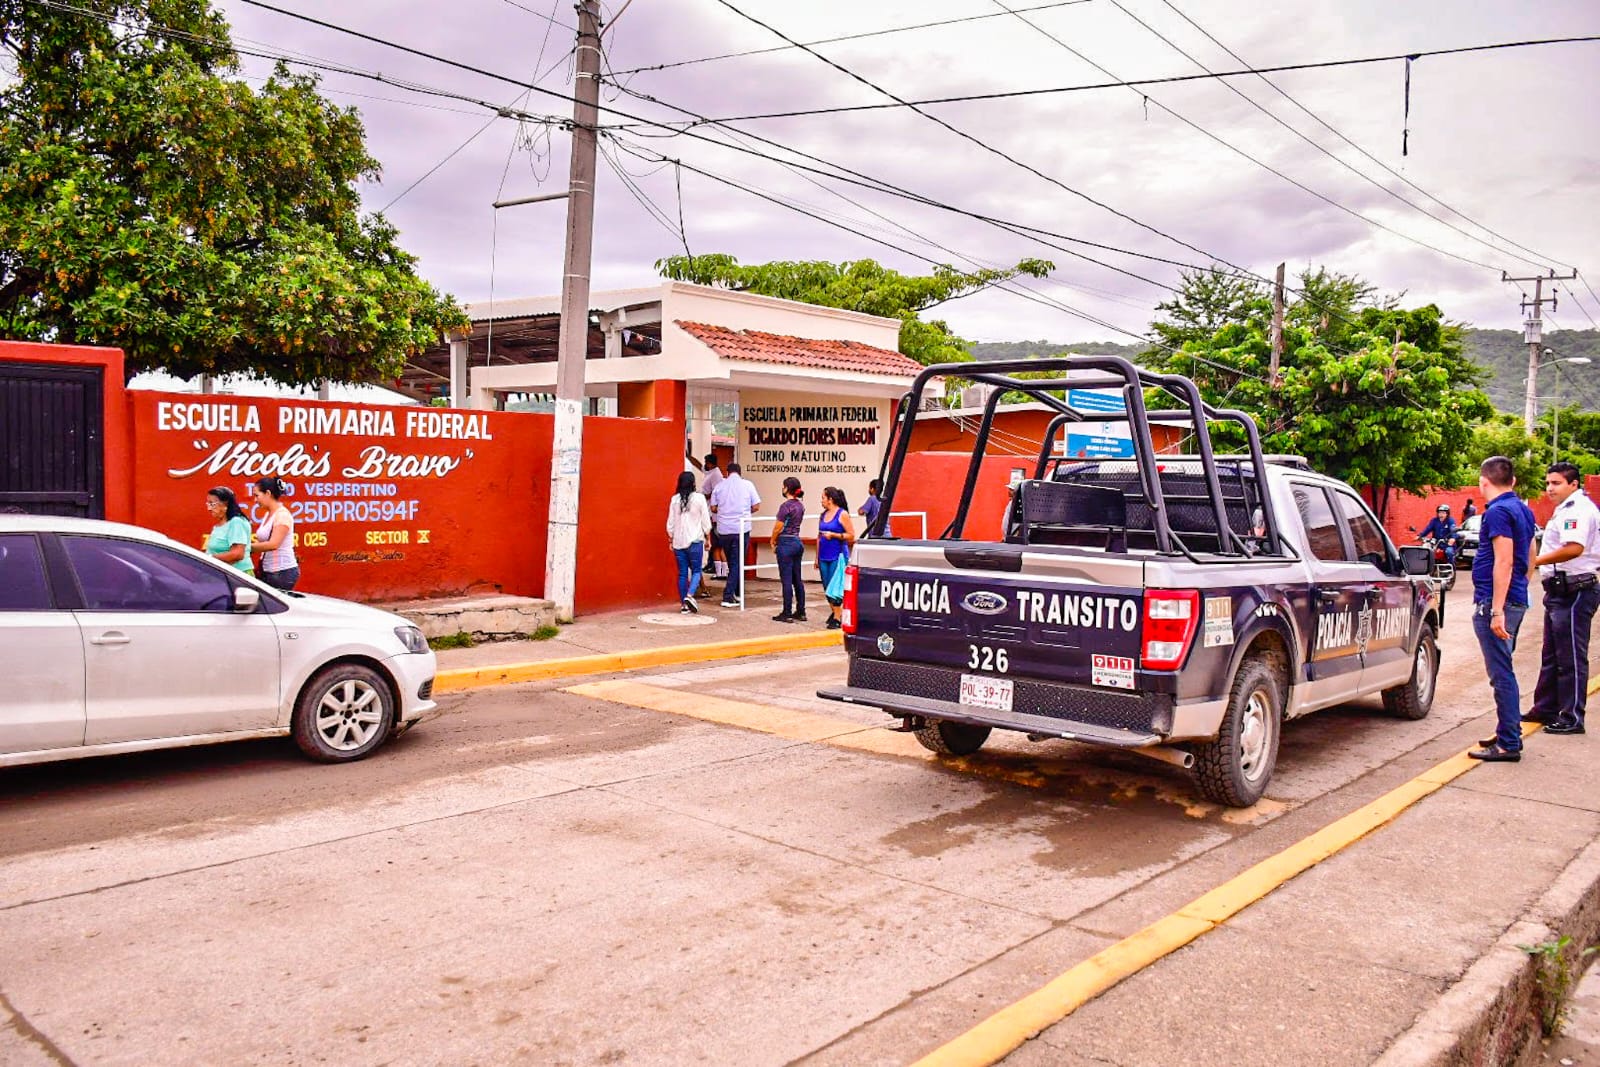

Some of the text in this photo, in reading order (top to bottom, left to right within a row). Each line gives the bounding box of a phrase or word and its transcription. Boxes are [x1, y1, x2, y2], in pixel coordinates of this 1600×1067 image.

[158, 402, 493, 440] ESCUELA PRIMARIA FEDERAL
[744, 407, 878, 422] ESCUELA PRIMARIA FEDERAL
[799, 427, 835, 445] FLORES
[754, 450, 846, 462] TURNO MATUTINO
[305, 483, 397, 497] VESPERTINO
[304, 532, 327, 546] 025
[366, 530, 409, 545] SECTOR
[417, 530, 430, 543] X
[880, 579, 951, 614] POLICÍA
[1016, 591, 1137, 632] TRANSITO
[1207, 602, 1229, 617] 911
[1316, 604, 1352, 650] POLICÍA
[1375, 607, 1410, 640] TRANSITO
[968, 645, 1009, 673] 326
[1095, 656, 1131, 670] 911
[962, 682, 1010, 701] POL-39-77
